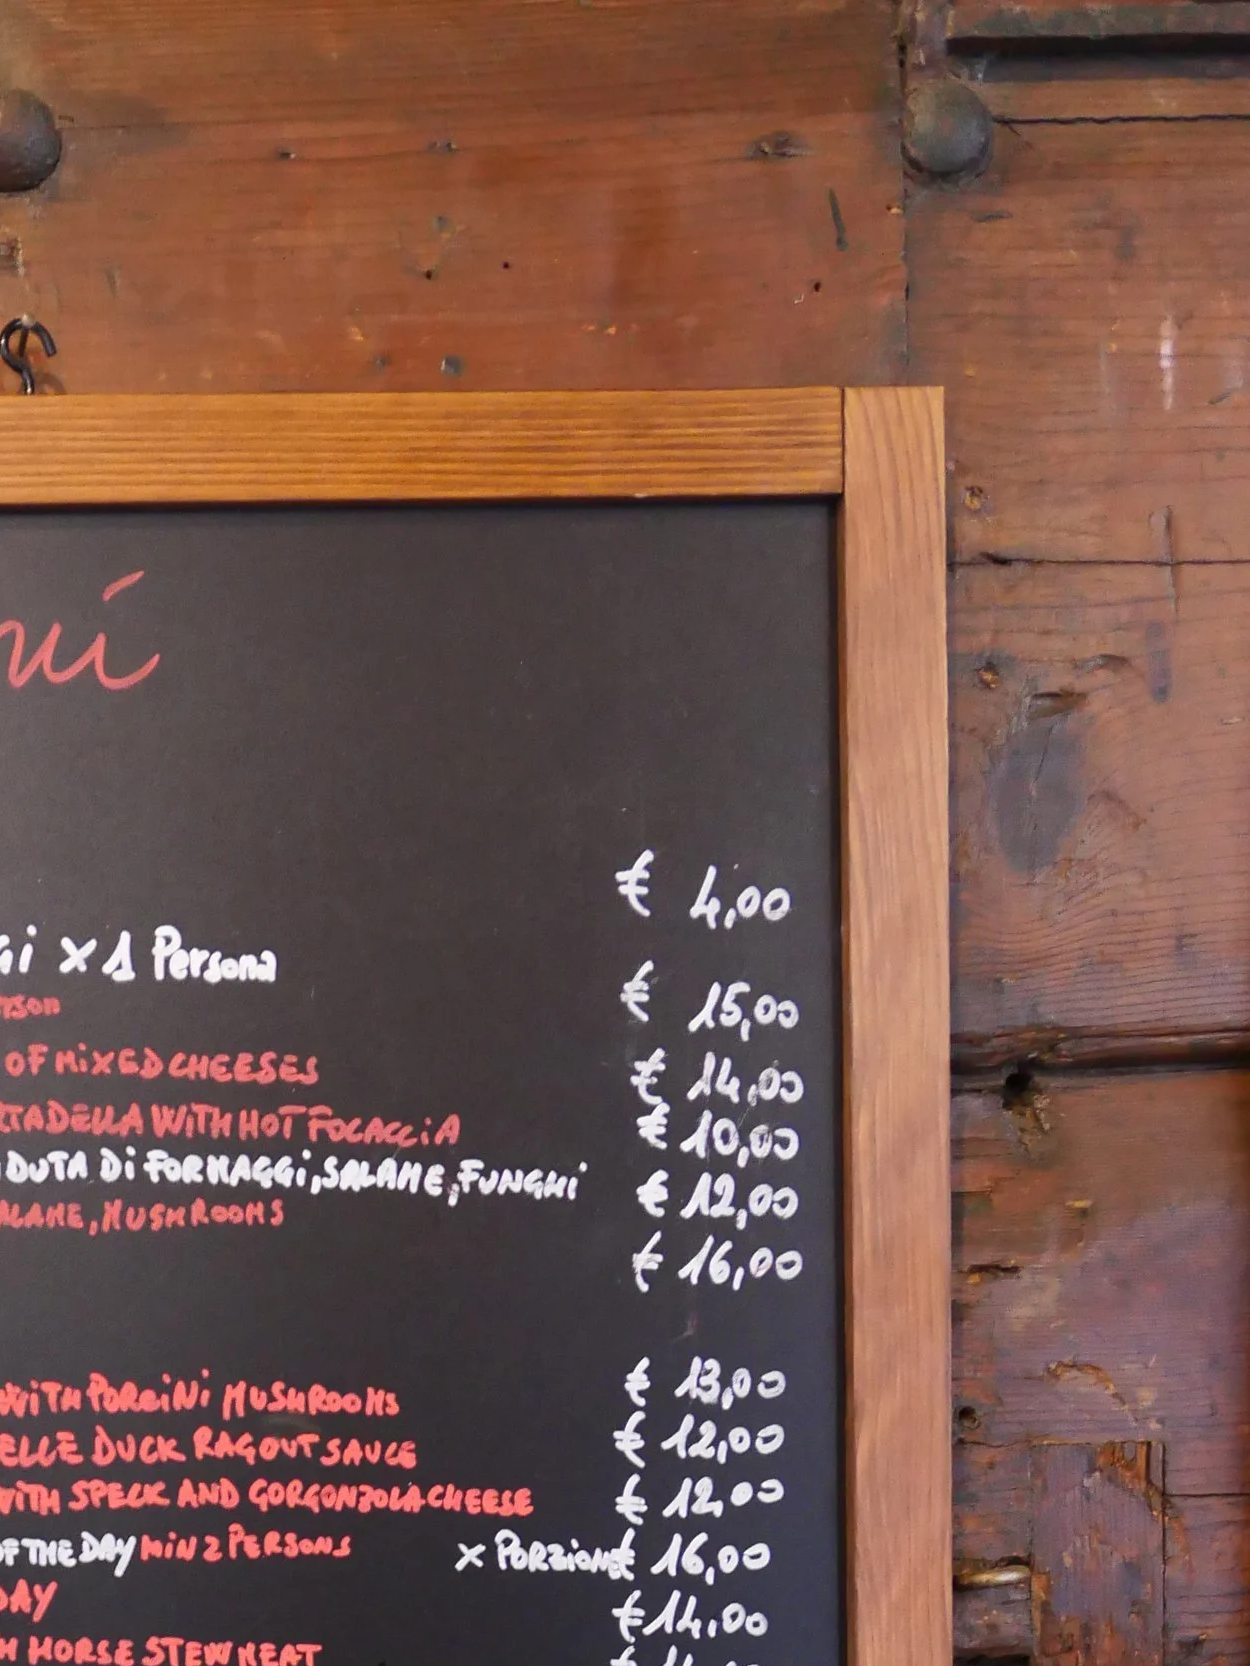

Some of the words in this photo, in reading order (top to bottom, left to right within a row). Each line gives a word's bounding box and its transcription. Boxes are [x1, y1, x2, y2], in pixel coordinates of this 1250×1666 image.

[614, 849, 655, 917] €
[689, 865, 791, 930] 4,00
[101, 930, 136, 983] 1
[151, 924, 277, 984] Persona
[619, 959, 654, 1023] €
[687, 981, 799, 1042] 15,00
[4, 1043, 48, 1078] OF
[167, 1050, 319, 1085] CHEESES
[629, 1047, 671, 1103] €
[686, 1051, 804, 1107] 14,00
[635, 1102, 671, 1150] €
[679, 1109, 799, 1169] 10,00
[635, 1169, 669, 1218] €
[679, 1171, 799, 1231] 12,00
[631, 1230, 664, 1293] €
[677, 1234, 803, 1291] 16,00
[221, 1379, 400, 1421] MUSHROOMS
[624, 1356, 651, 1407] €
[674, 1355, 786, 1411] 13,00
[90, 1423, 187, 1467] DUCK
[191, 1423, 321, 1466] RAGOUT
[320, 1436, 418, 1471] SAUCE
[612, 1410, 646, 1469] €
[660, 1413, 785, 1465] 12,00
[68, 1478, 171, 1512] SPECK
[176, 1475, 241, 1510] AND
[227, 1521, 351, 1561] PERSONS
[650, 1531, 771, 1586] 16,00
[641, 1589, 768, 1640] 14,00
